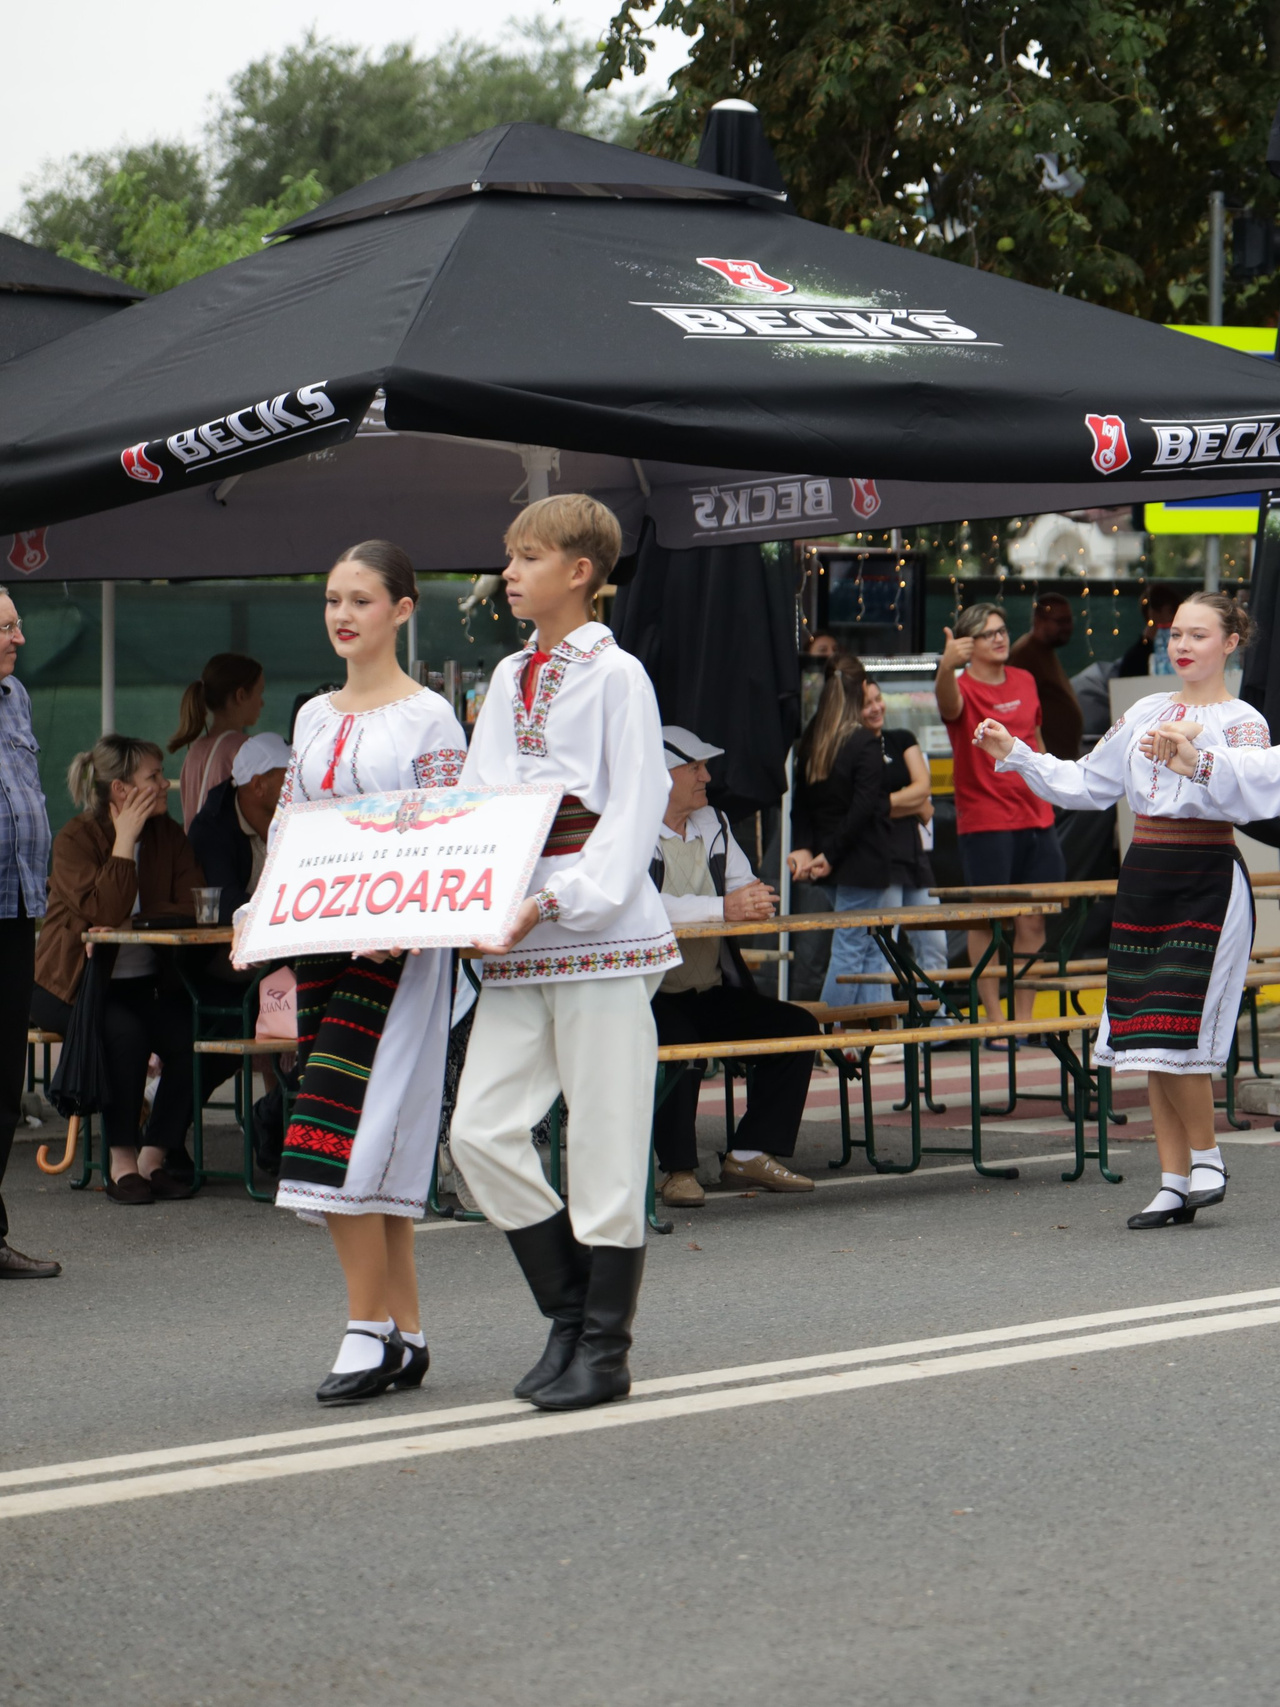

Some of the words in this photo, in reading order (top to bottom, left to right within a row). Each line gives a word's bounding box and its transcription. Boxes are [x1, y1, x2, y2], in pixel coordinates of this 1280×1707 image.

[652, 308, 977, 340] BECK'S
[166, 380, 335, 465] BECKS
[372, 849, 389, 859] DE
[396, 846, 429, 858] DANS
[437, 844, 497, 856] POPULAR
[269, 868, 493, 926] LOZIOARA
